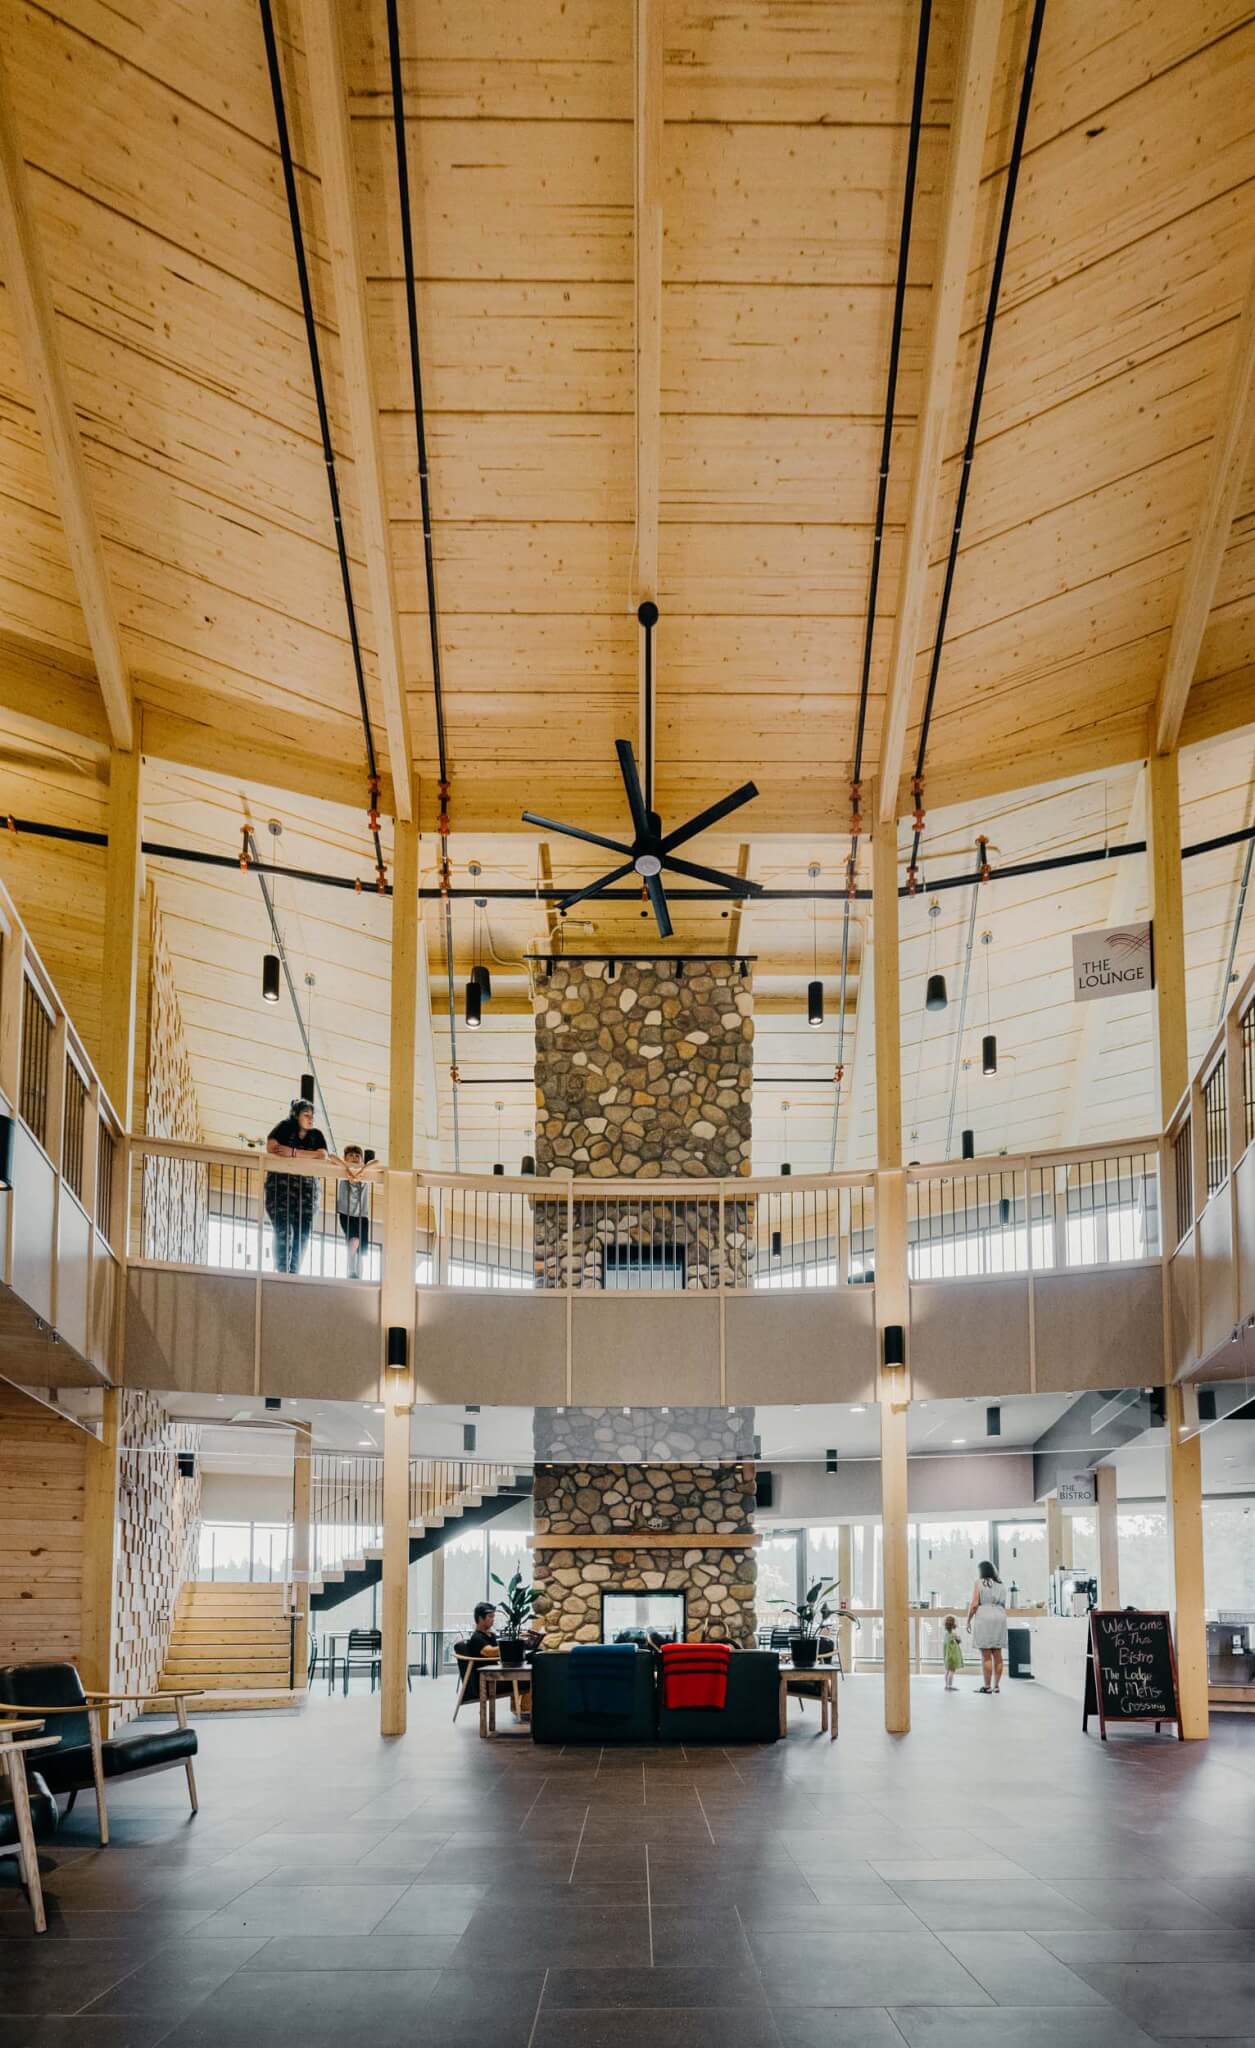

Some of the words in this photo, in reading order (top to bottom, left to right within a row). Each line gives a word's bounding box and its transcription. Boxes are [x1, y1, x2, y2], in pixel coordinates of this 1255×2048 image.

[1082, 958, 1110, 974] THE
[1079, 967, 1145, 989] LOUNGE
[1059, 1491, 1092, 1500] BISTRO
[1061, 1484, 1075, 1492] THE
[1101, 1617, 1164, 1633] Welcome
[1111, 1633, 1124, 1647] To
[1130, 1632, 1152, 1645] The
[1119, 1647, 1154, 1665] Bistro
[1102, 1667, 1120, 1680] The
[1124, 1667, 1152, 1683] Lodge
[1108, 1682, 1119, 1696] At
[1120, 1697, 1166, 1713] Crossing
